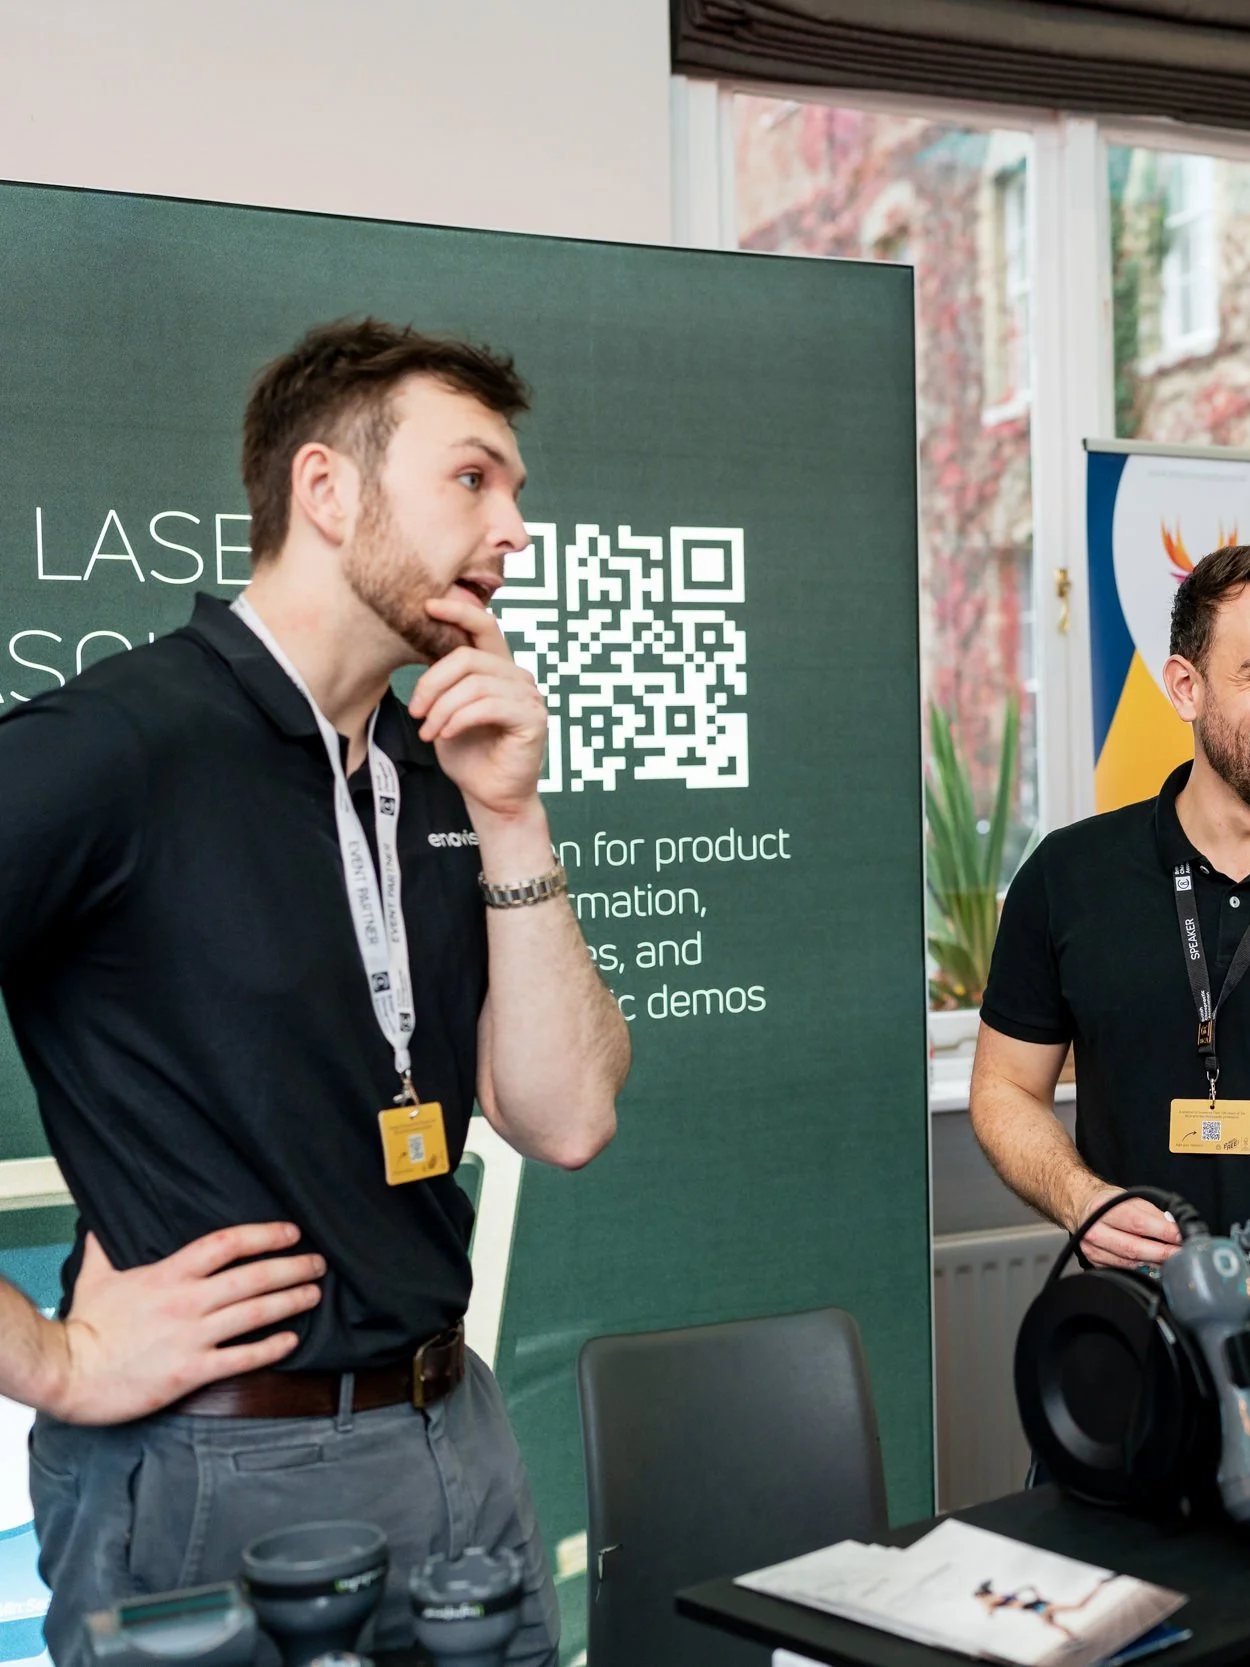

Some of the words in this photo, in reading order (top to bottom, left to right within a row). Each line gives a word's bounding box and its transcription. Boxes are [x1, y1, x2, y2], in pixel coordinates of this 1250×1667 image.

[428, 829, 480, 848] enovis
[594, 832, 645, 867] for
[656, 827, 791, 873] product
[567, 884, 707, 919] mation,
[636, 931, 702, 968] and
[1184, 918, 1201, 961] SPEAKER
[647, 984, 767, 1020] demos
